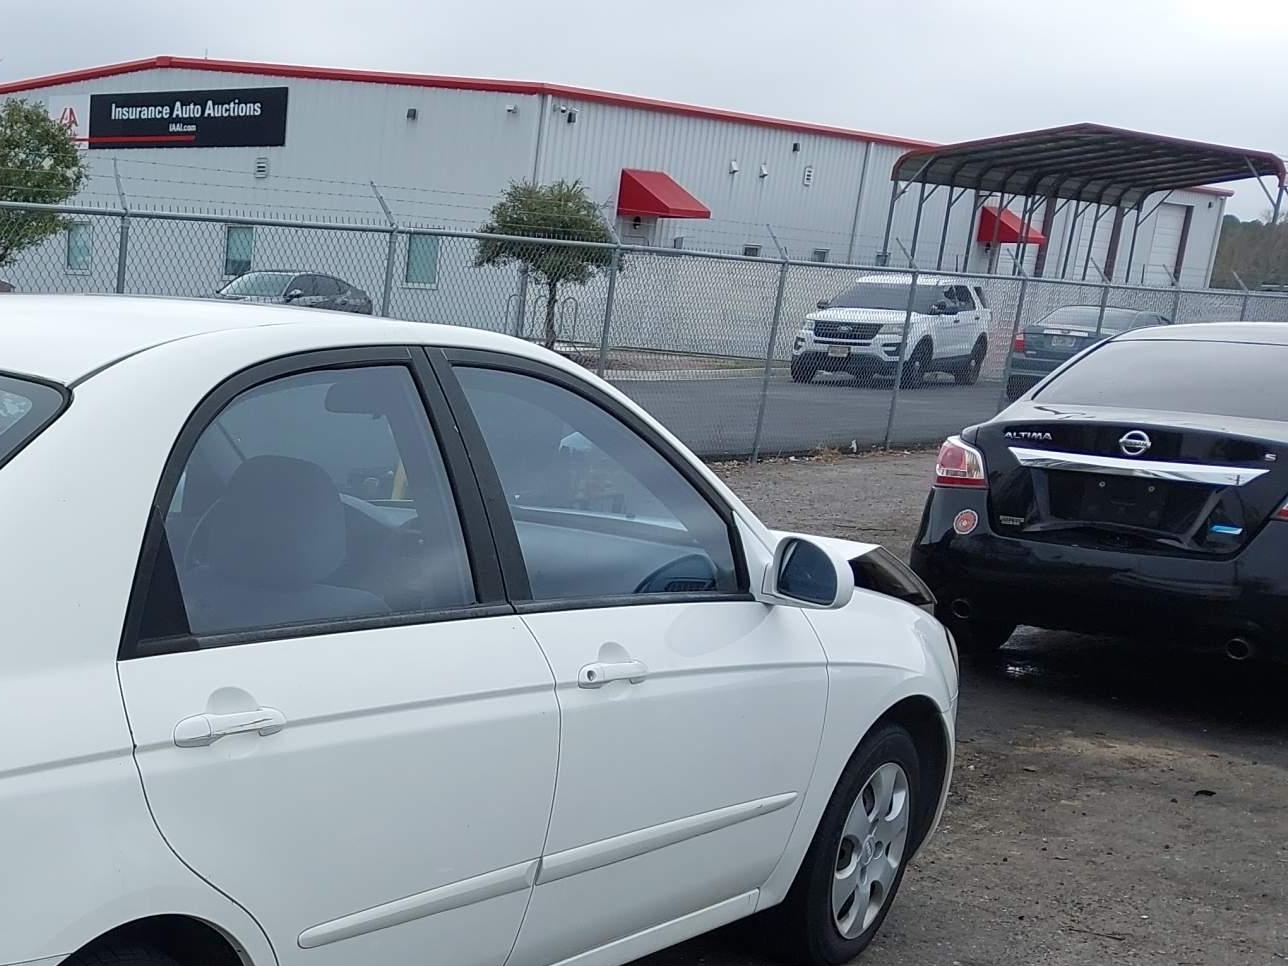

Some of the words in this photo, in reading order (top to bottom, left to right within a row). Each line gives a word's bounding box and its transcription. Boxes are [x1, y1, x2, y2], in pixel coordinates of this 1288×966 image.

[111, 103, 170, 120] Insurance
[172, 101, 202, 118] Auto
[204, 99, 262, 118] Auctions
[1004, 431, 1052, 440] ALTIMA
[1264, 453, 1277, 461] S
